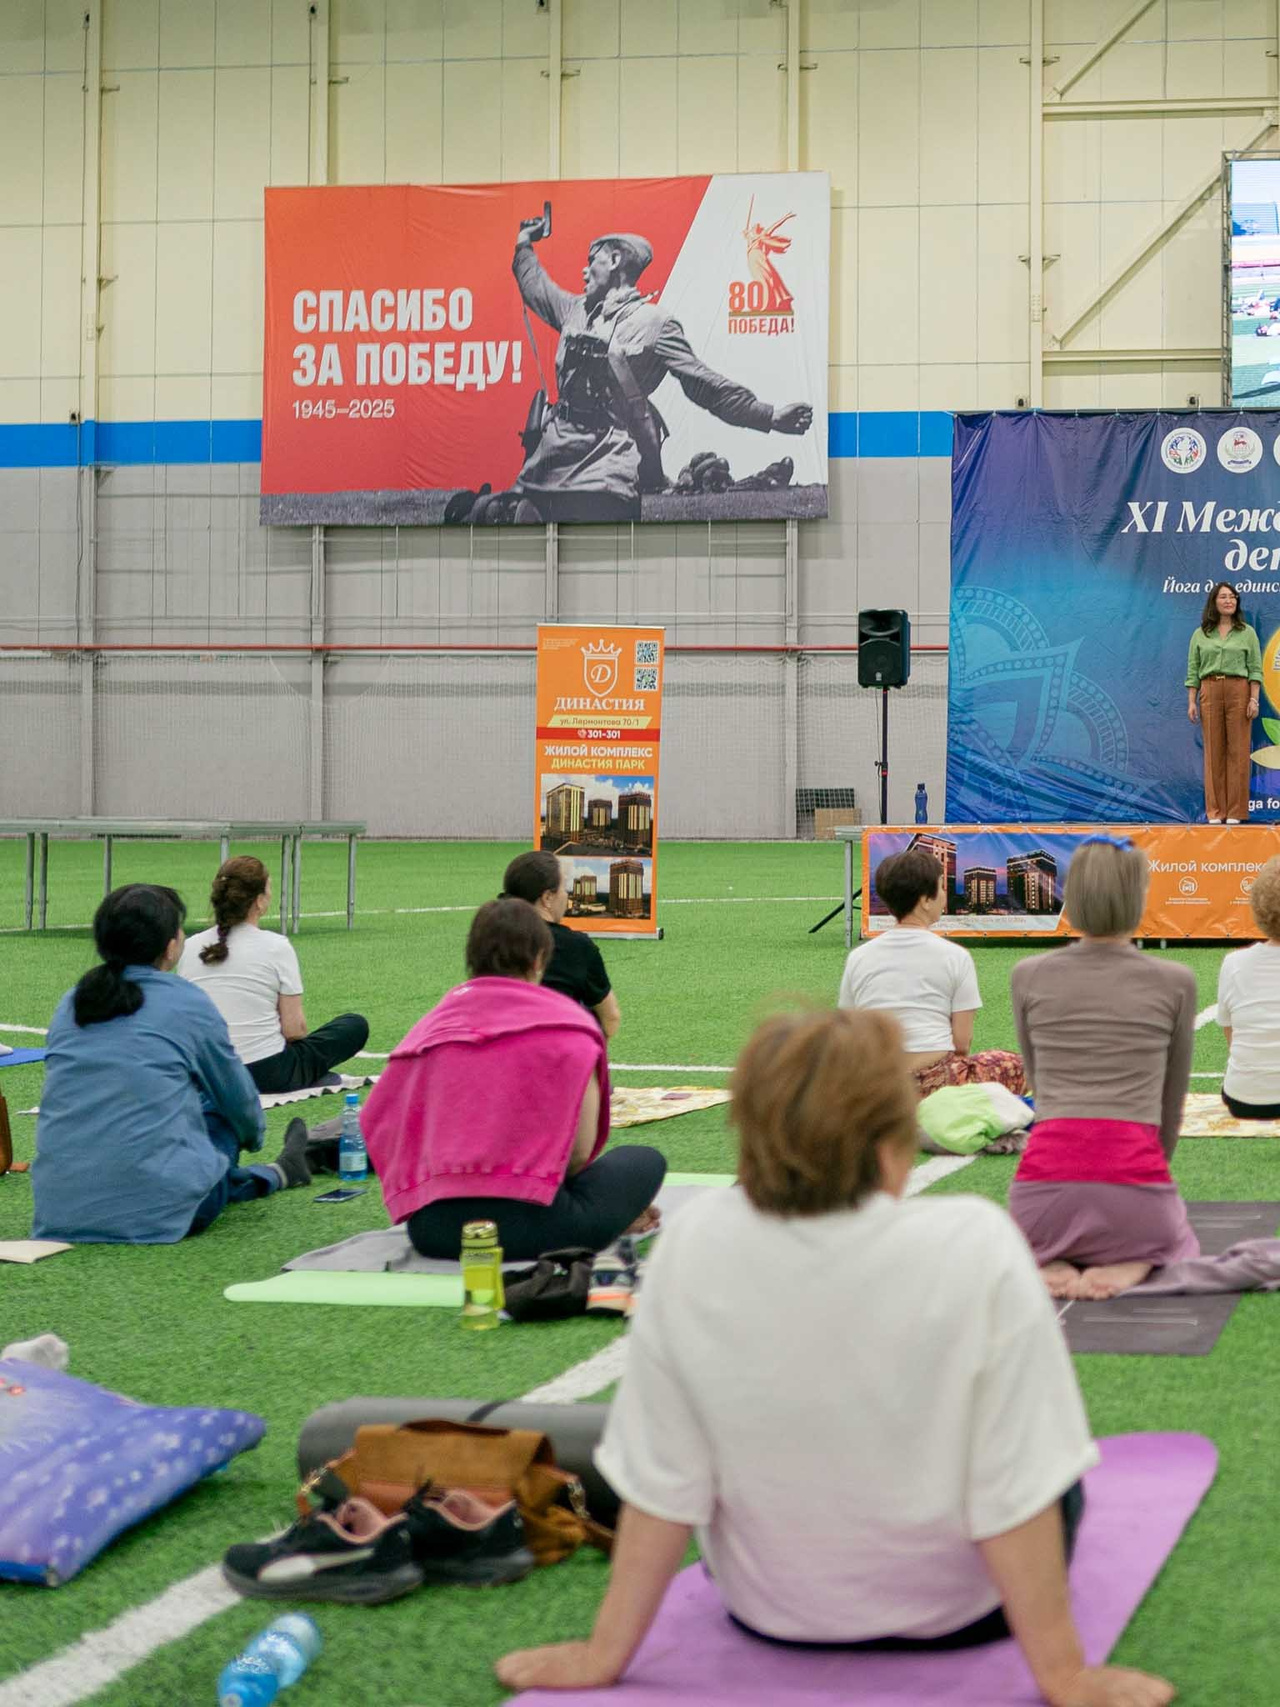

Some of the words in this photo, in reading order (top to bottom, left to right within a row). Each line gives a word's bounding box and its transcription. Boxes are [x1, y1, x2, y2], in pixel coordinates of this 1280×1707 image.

[729, 281, 764, 311] 80
[293, 288, 473, 333] СПАСИБО
[728, 317, 794, 336] ПОБЕДА!
[292, 343, 344, 387] ЗА
[356, 341, 522, 391] ПОБЕДУ!
[1121, 501, 1171, 533] XI
[1163, 576, 1201, 593] Йога
[554, 697, 645, 711] ДИНАСТИЯ
[572, 717, 621, 726] Лермонтова
[623, 718, 639, 726] 70/1
[587, 730, 621, 739] 301-301
[544, 744, 588, 757] ЖИЛОЙ
[590, 746, 653, 758] КОМПЛЕКС
[551, 758, 613, 769] ДИНАСТИЯ
[616, 759, 645, 770] ПАРК
[1148, 859, 1197, 873] Жилой
